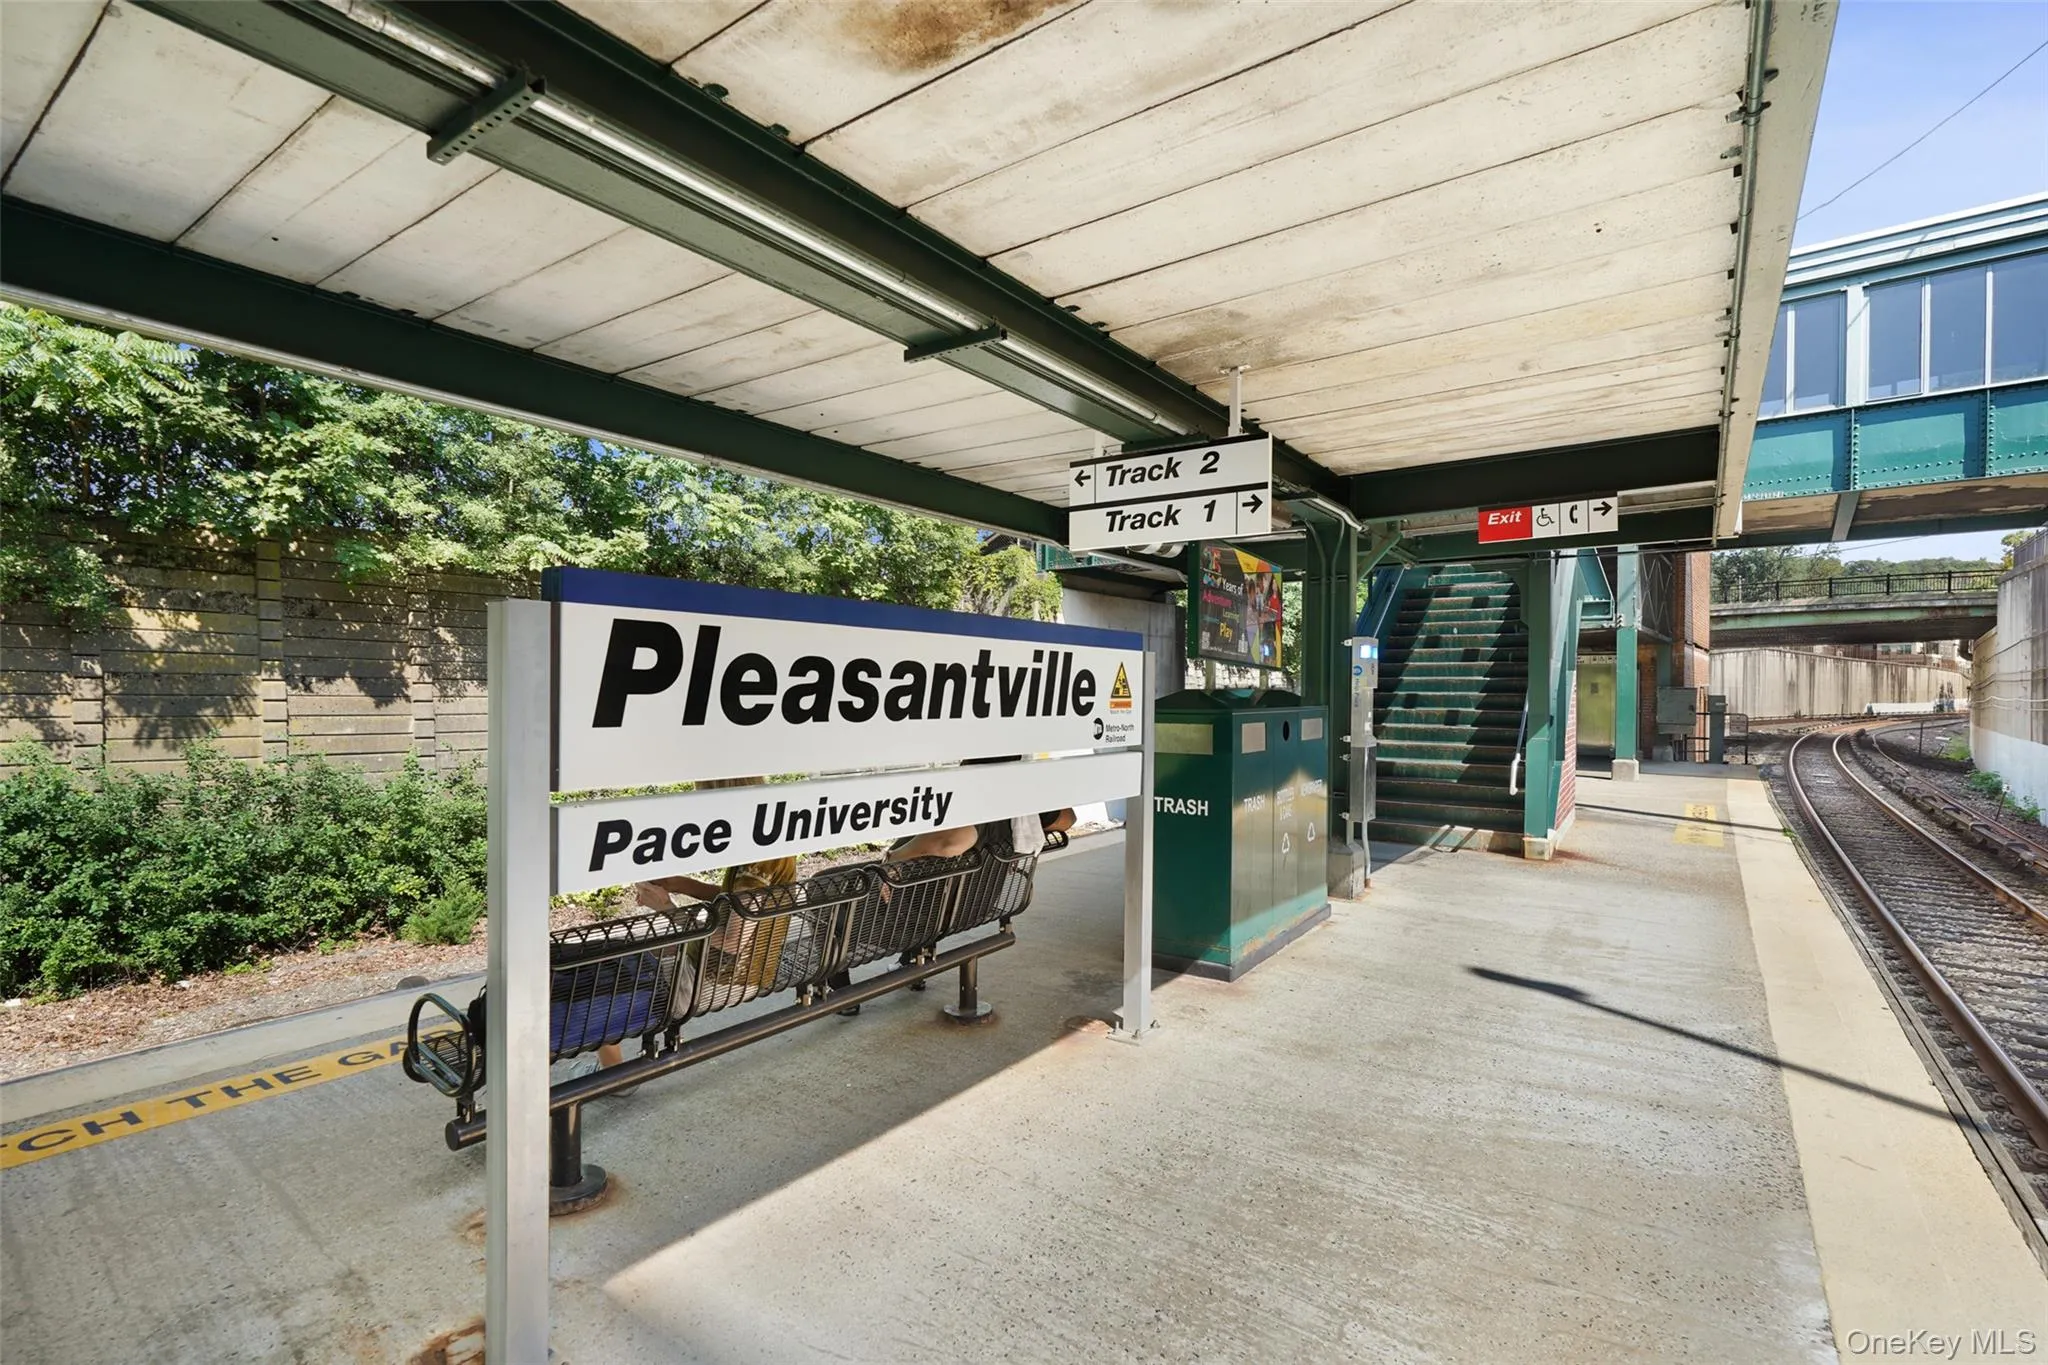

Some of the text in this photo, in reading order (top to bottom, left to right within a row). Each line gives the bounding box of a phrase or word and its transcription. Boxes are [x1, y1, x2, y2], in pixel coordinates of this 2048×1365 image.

[1105, 450, 1221, 487] Track 2
[1105, 499, 1217, 533] Track 1
[1487, 510, 1522, 526] Exit
[1222, 578, 1237, 595] Years
[1219, 622, 1233, 643] Play
[591, 618, 1097, 729] Pleasantville
[1105, 724, 1135, 733] Metro-North
[1105, 734, 1127, 743] Railroad
[1154, 796, 1209, 816] TRASH
[1243, 794, 1266, 813] TRASH
[588, 785, 953, 872] Pace University
[0, 1110, 144, 1153] CH
[166, 1065, 323, 1110] THE
